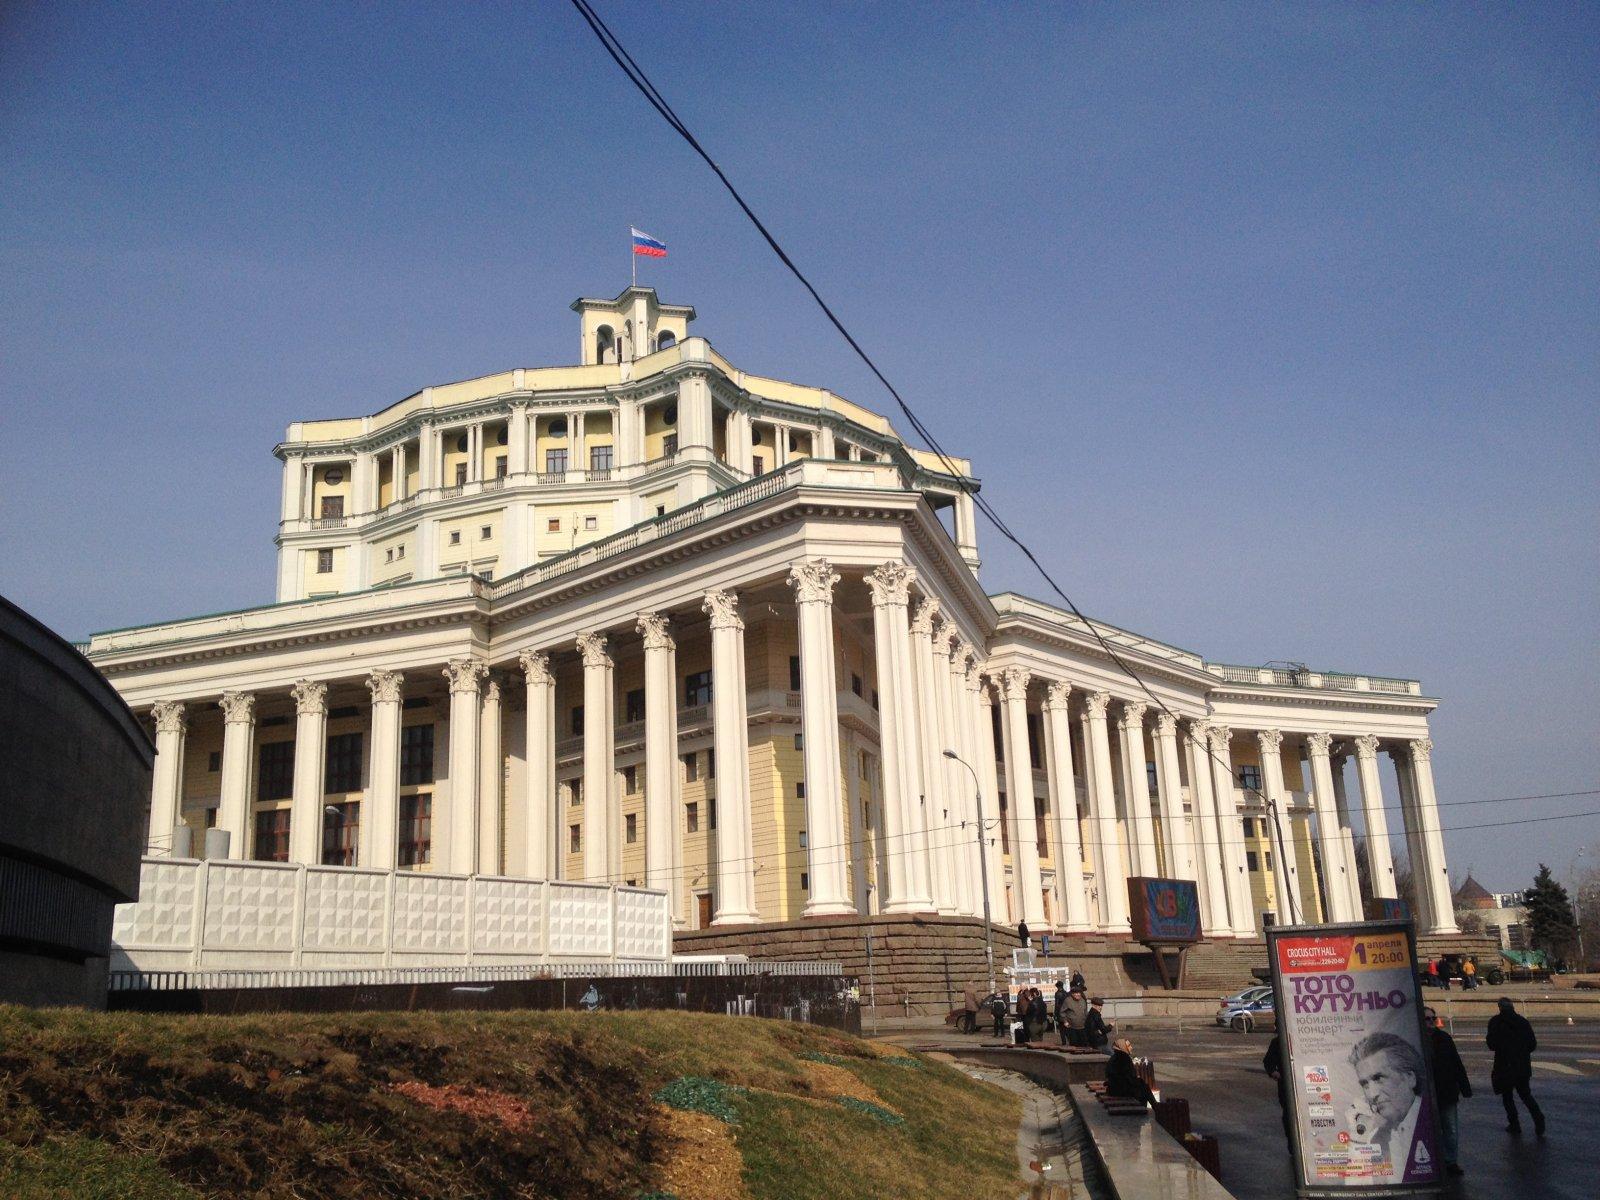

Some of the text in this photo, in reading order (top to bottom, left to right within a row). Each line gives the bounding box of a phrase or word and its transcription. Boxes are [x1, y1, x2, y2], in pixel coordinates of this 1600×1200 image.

[1287, 946, 1336, 958] CROCUS CITY HALL
[1354, 940, 1402, 964] 1 апреля
[1372, 952, 1404, 964] 20:00
[1290, 974, 1355, 995] ТОТО
[1296, 1014, 1364, 1025] юбилейный
[1298, 1024, 1343, 1037] концерт
[1339, 1133, 1349, 1143] 6+
